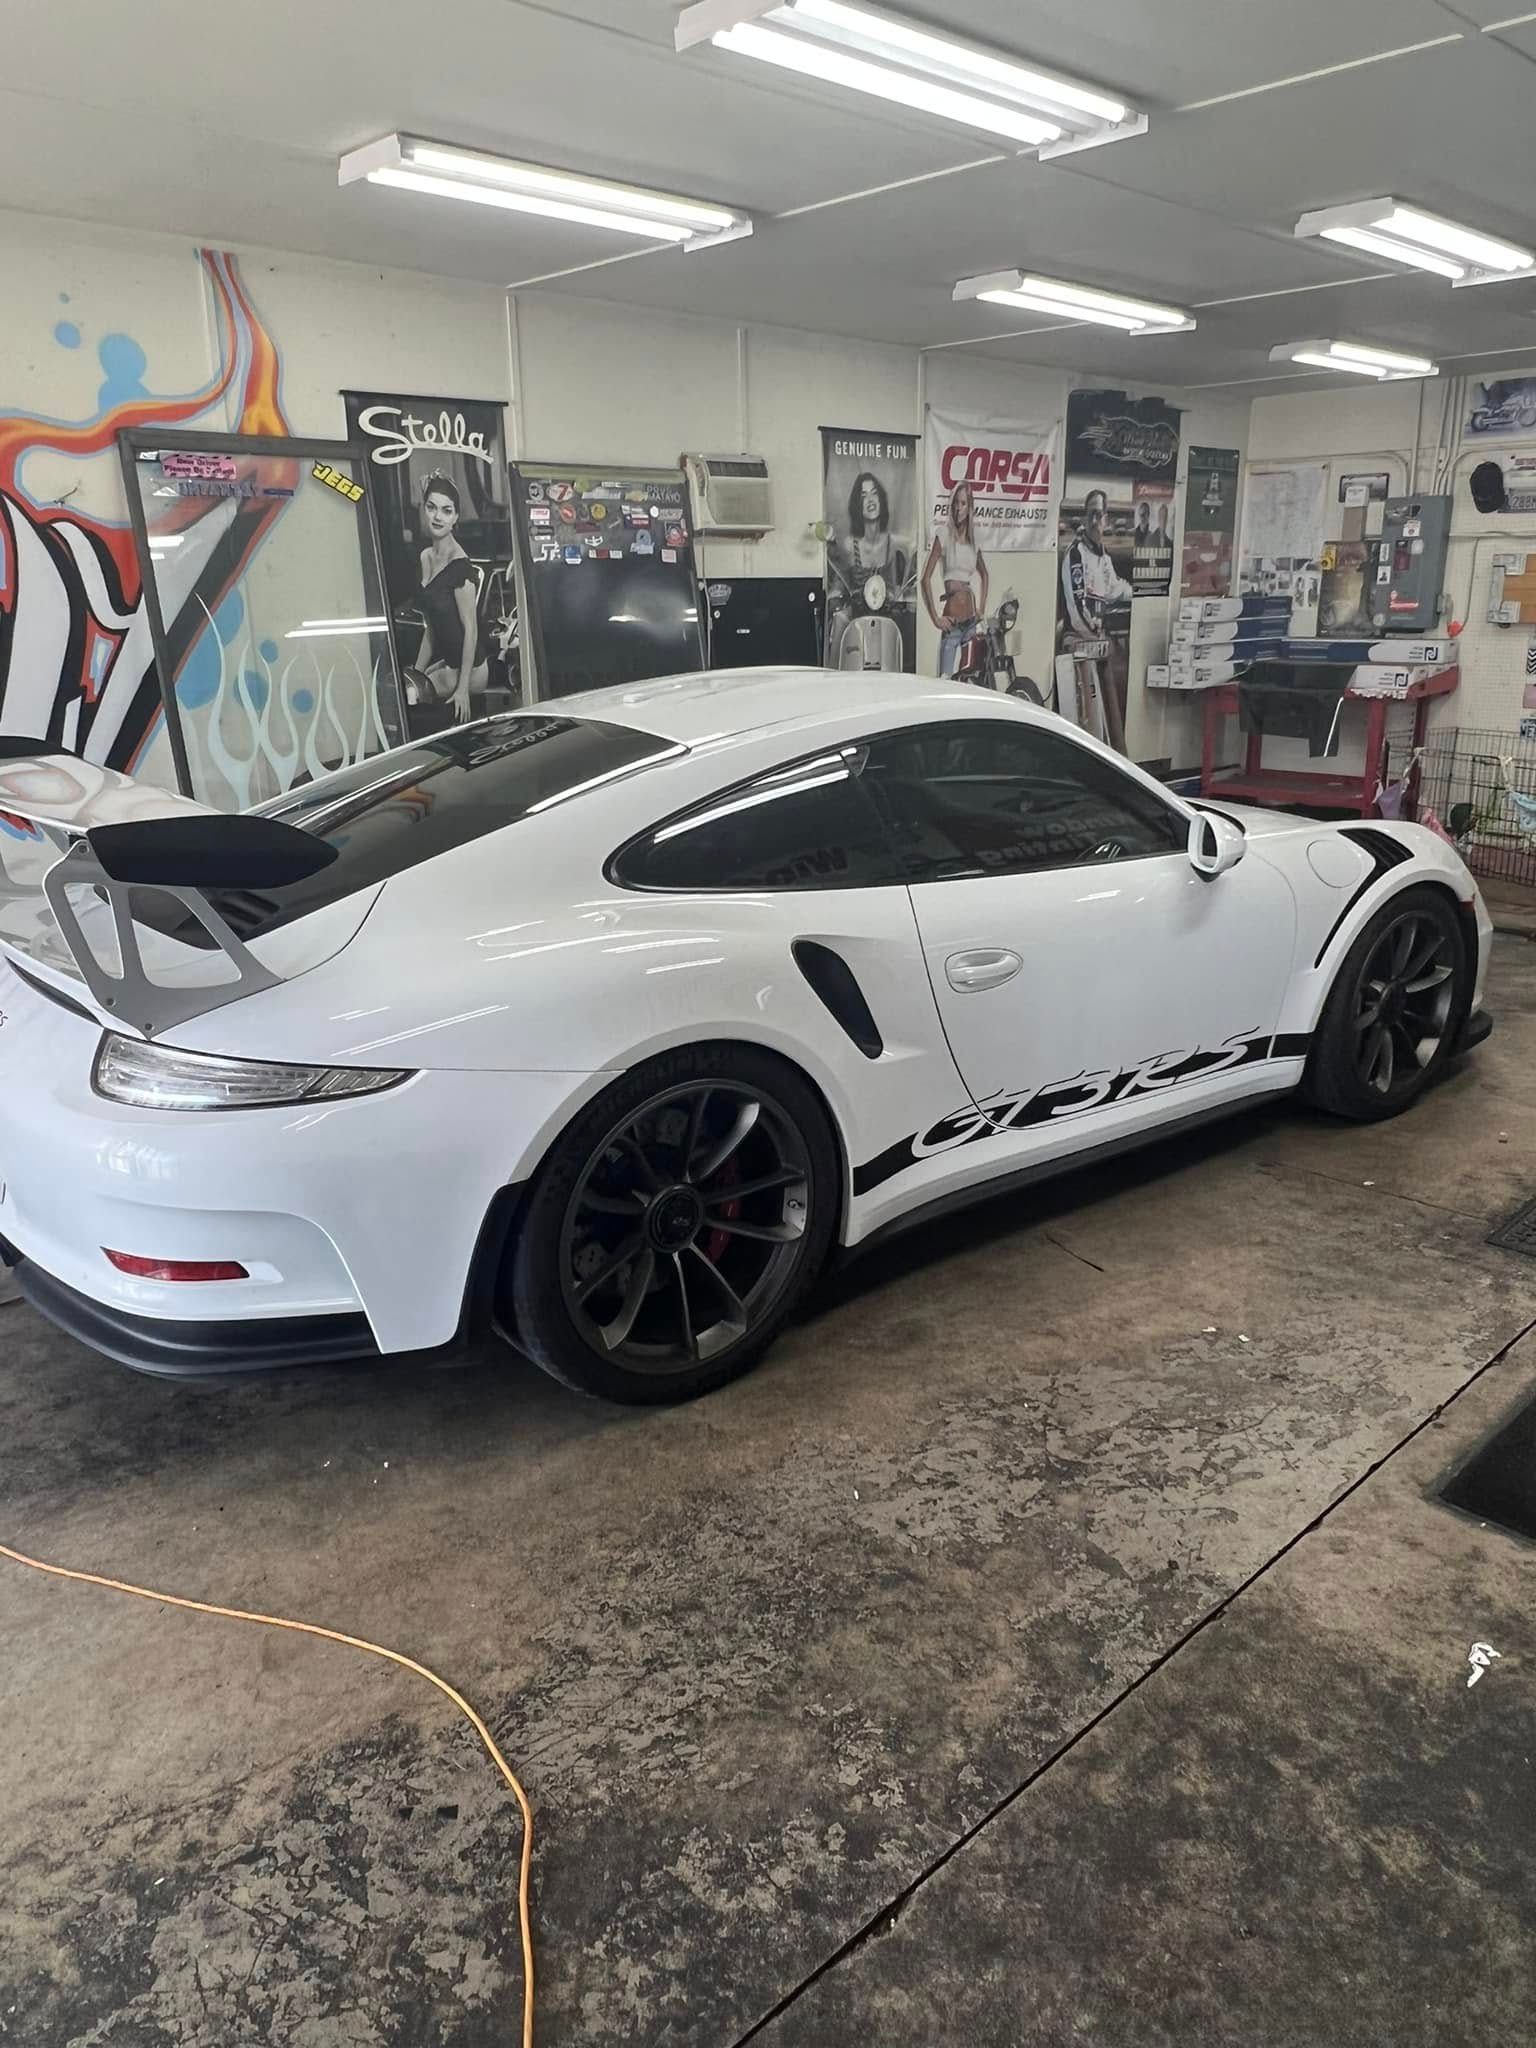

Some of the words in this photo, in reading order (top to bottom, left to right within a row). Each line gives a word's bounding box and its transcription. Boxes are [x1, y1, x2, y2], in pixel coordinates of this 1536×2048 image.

[358, 405, 494, 465] Stella
[835, 440, 882, 458] GENUINE
[886, 444, 907, 460] FUN
[312, 460, 365, 503] JEGS
[941, 445, 1049, 502] CORSA
[1005, 507, 1048, 521] EXHAUSTS
